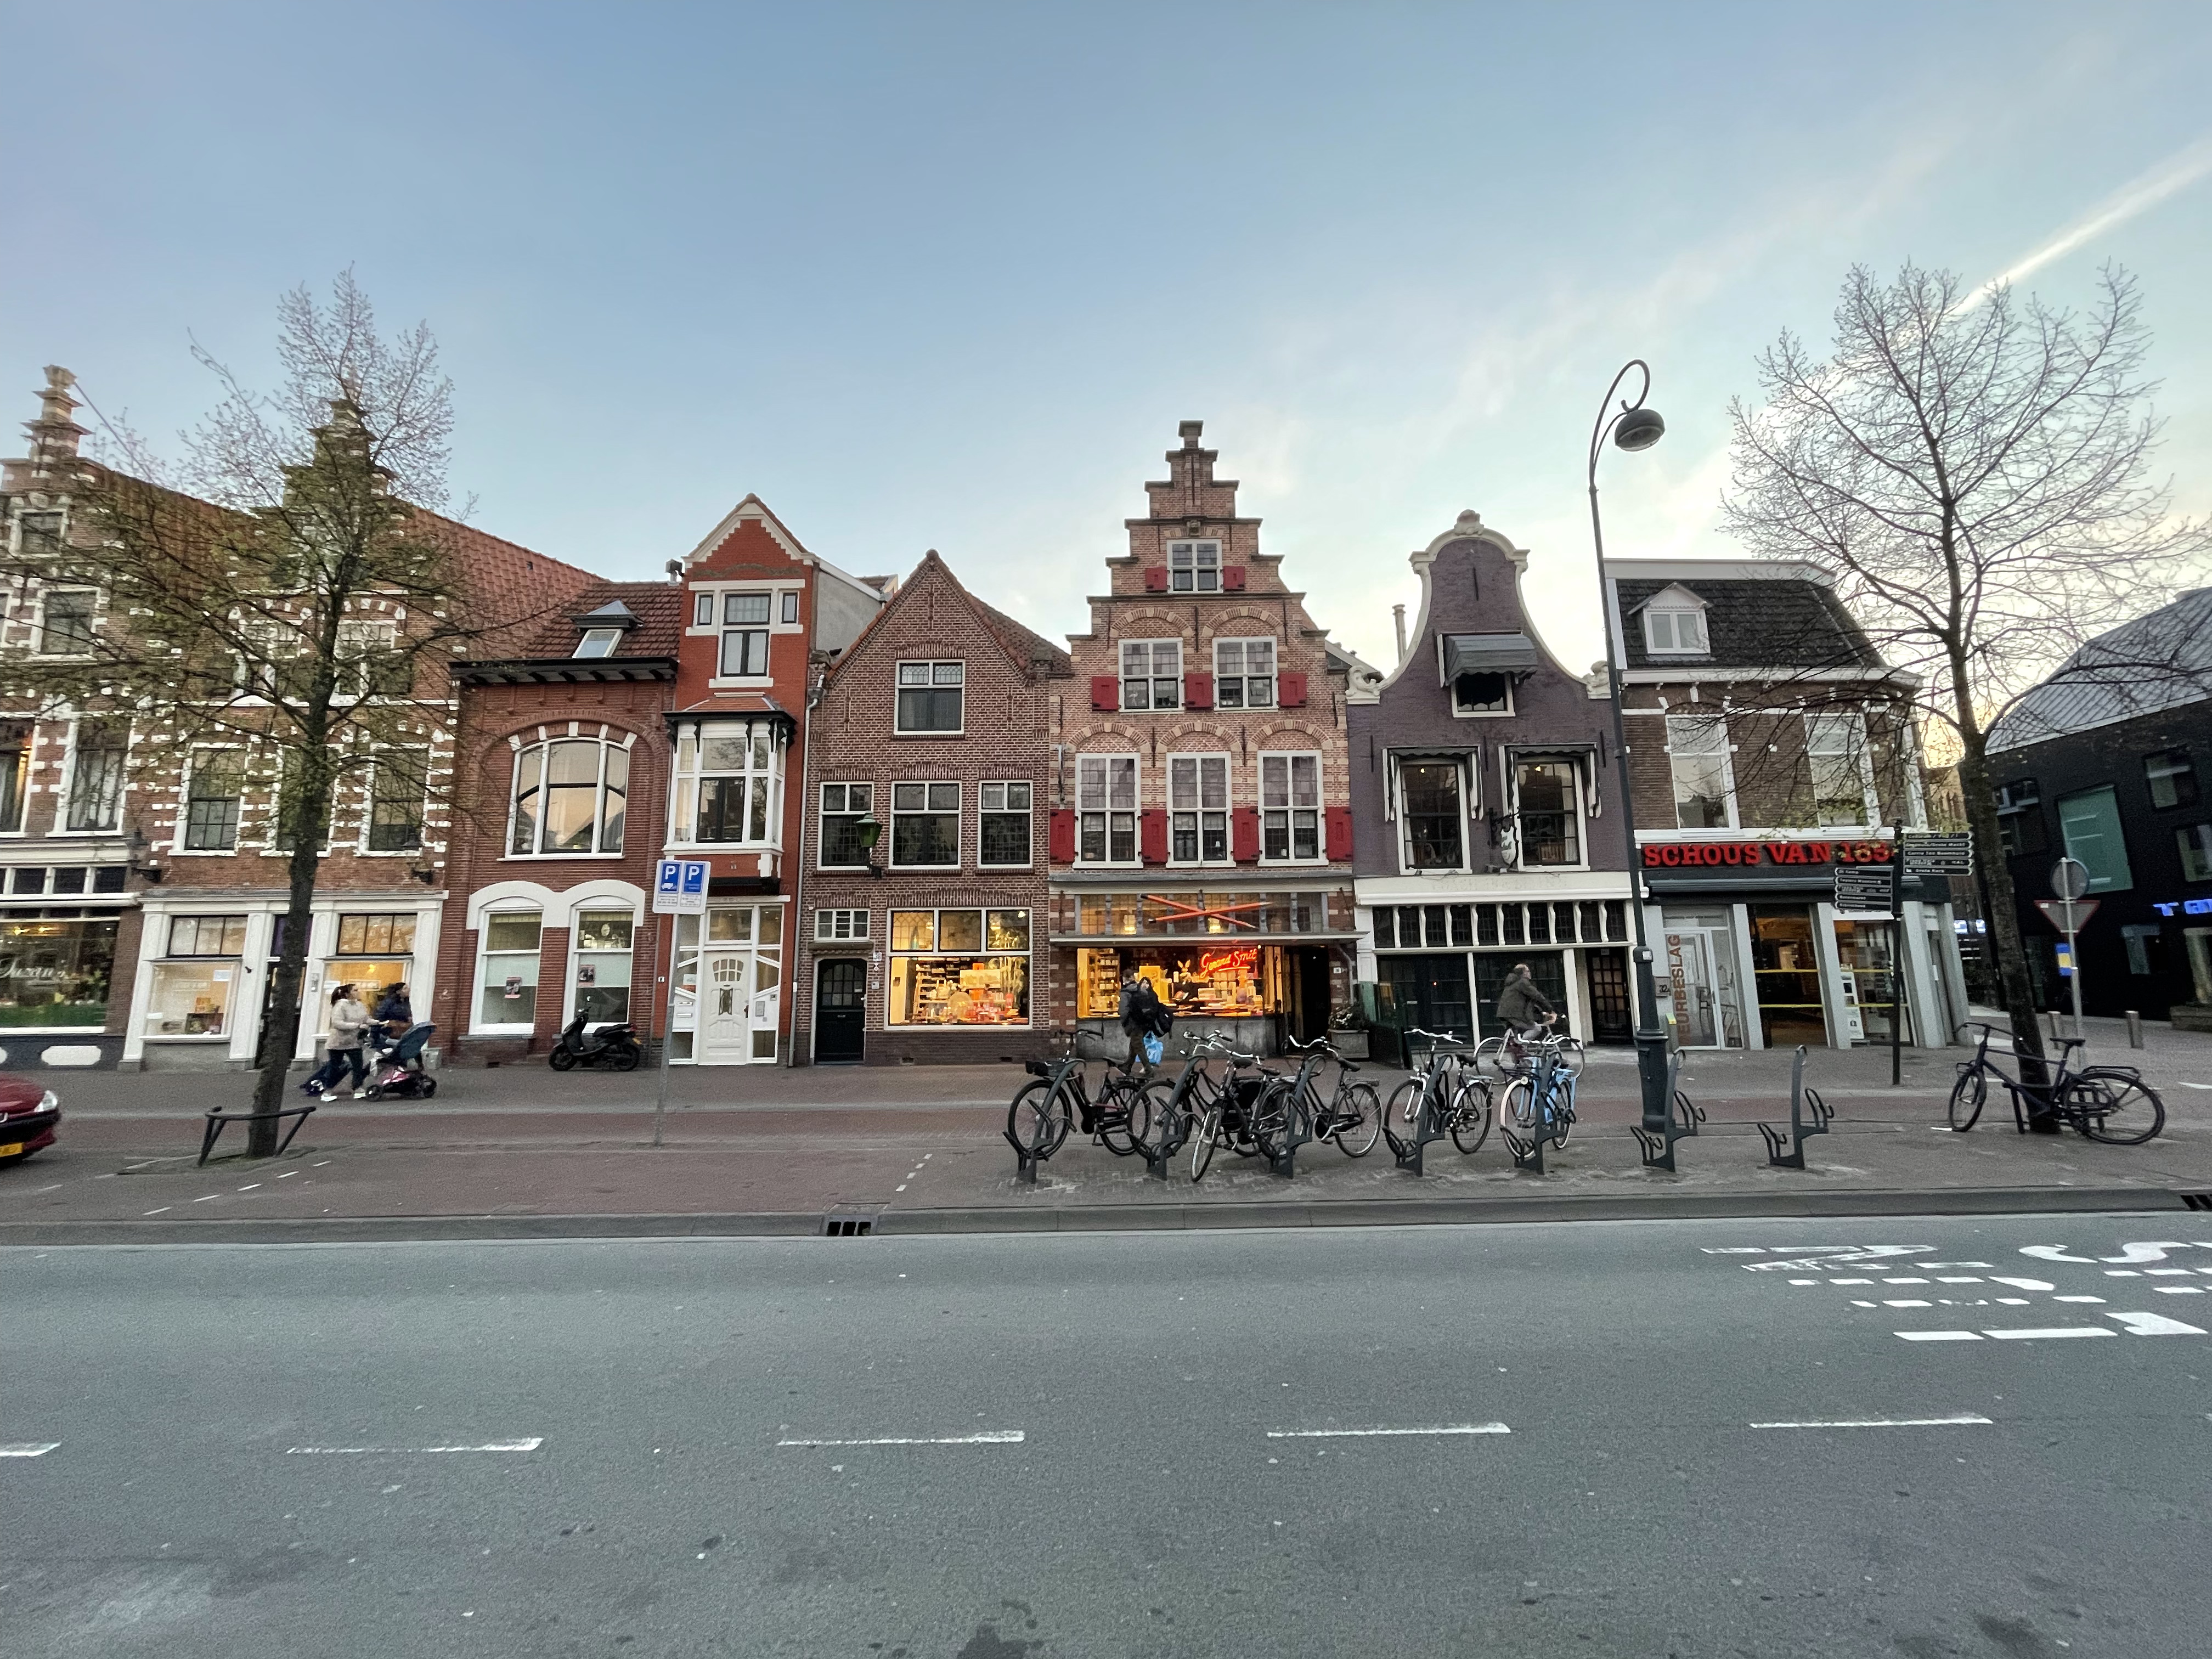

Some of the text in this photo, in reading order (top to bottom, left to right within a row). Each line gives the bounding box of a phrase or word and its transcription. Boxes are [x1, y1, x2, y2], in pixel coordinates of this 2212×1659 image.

[1643, 840, 1895, 867] SCHOUS VAN 185
[665, 865, 676, 880] P
[688, 866, 699, 881] P
[1233, 948, 1257, 967] Smit
